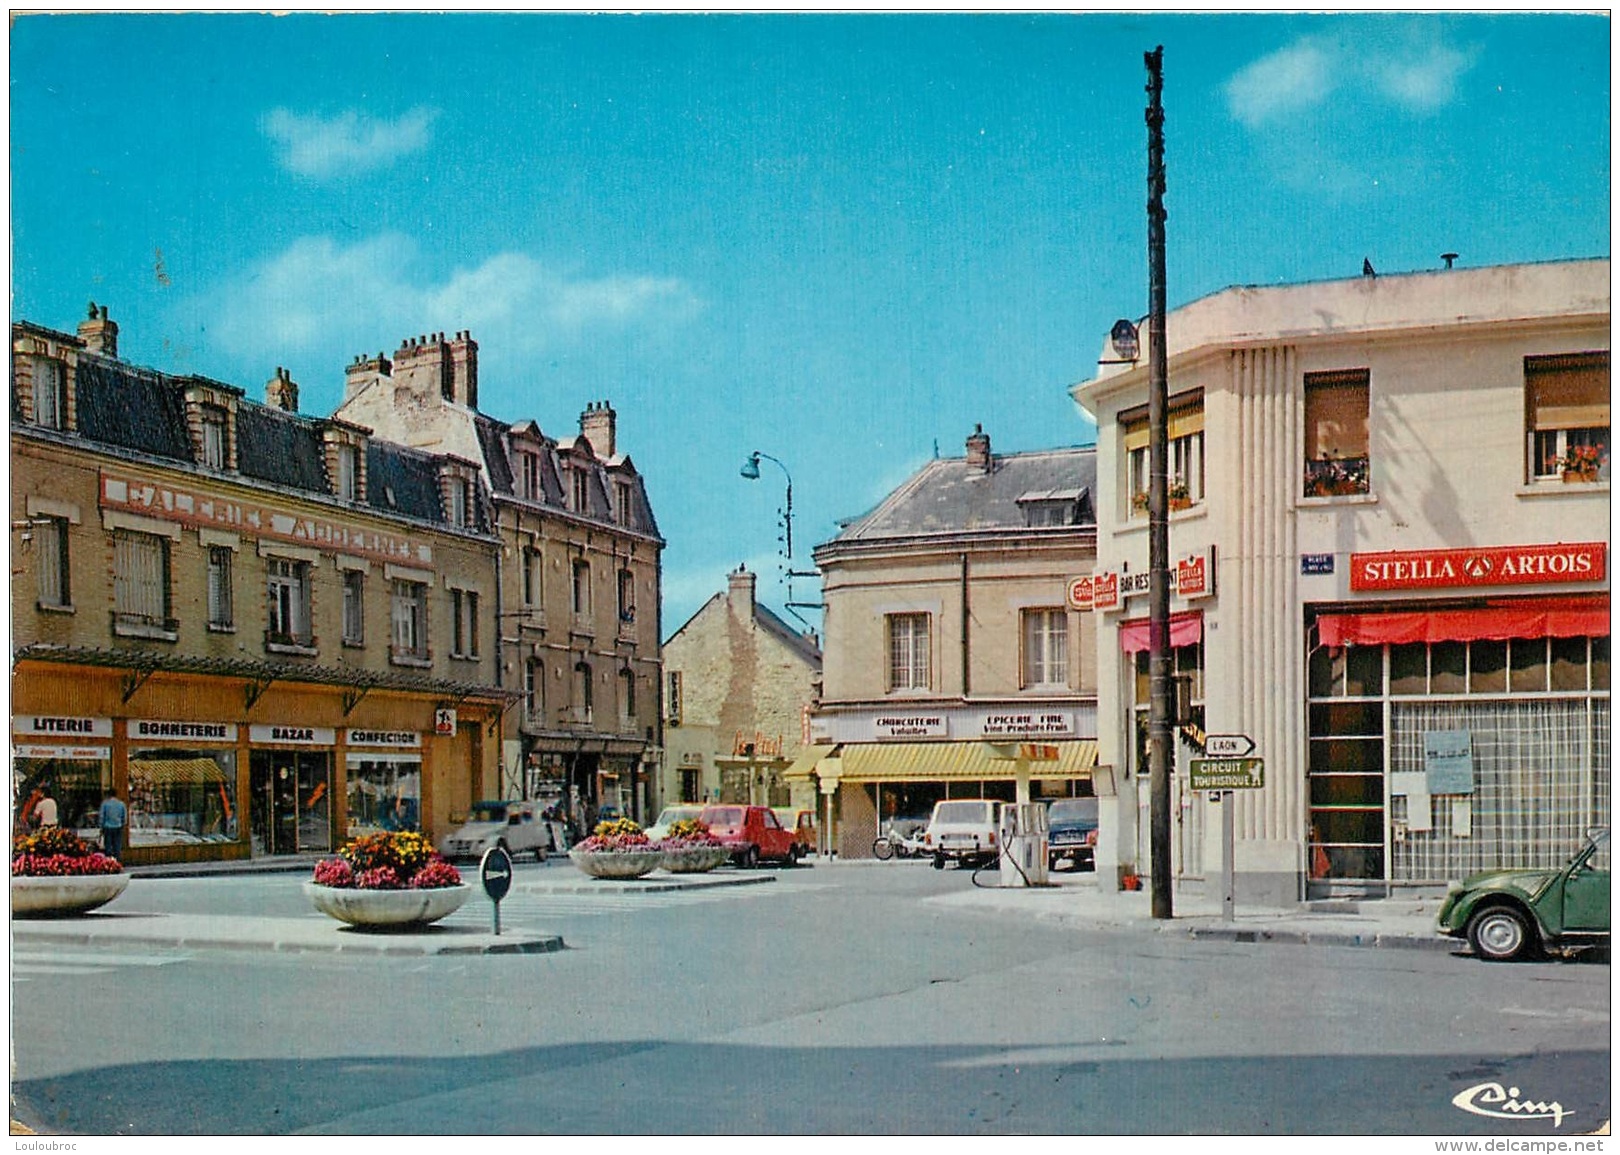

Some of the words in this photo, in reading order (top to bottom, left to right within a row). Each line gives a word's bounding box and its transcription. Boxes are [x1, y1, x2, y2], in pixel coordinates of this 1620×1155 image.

[1365, 559, 1455, 581] STELLA
[1500, 552, 1592, 575] ARTOIS
[1180, 567, 1202, 580] STELLA
[1095, 581, 1115, 594] STELLA
[1120, 576, 1134, 593] BAR
[33, 717, 93, 733] LITERIE
[987, 715, 1031, 724] EPICERIE
[1041, 714, 1063, 723] FINE
[139, 722, 227, 737] BONNETERIE
[271, 727, 314, 741] BAZAR
[351, 731, 416, 743] CONFECTION
[1213, 741, 1237, 750] LAON
[1200, 762, 1241, 773] CIRCUIT
[1193, 775, 1249, 787] TOURISTIQUE
